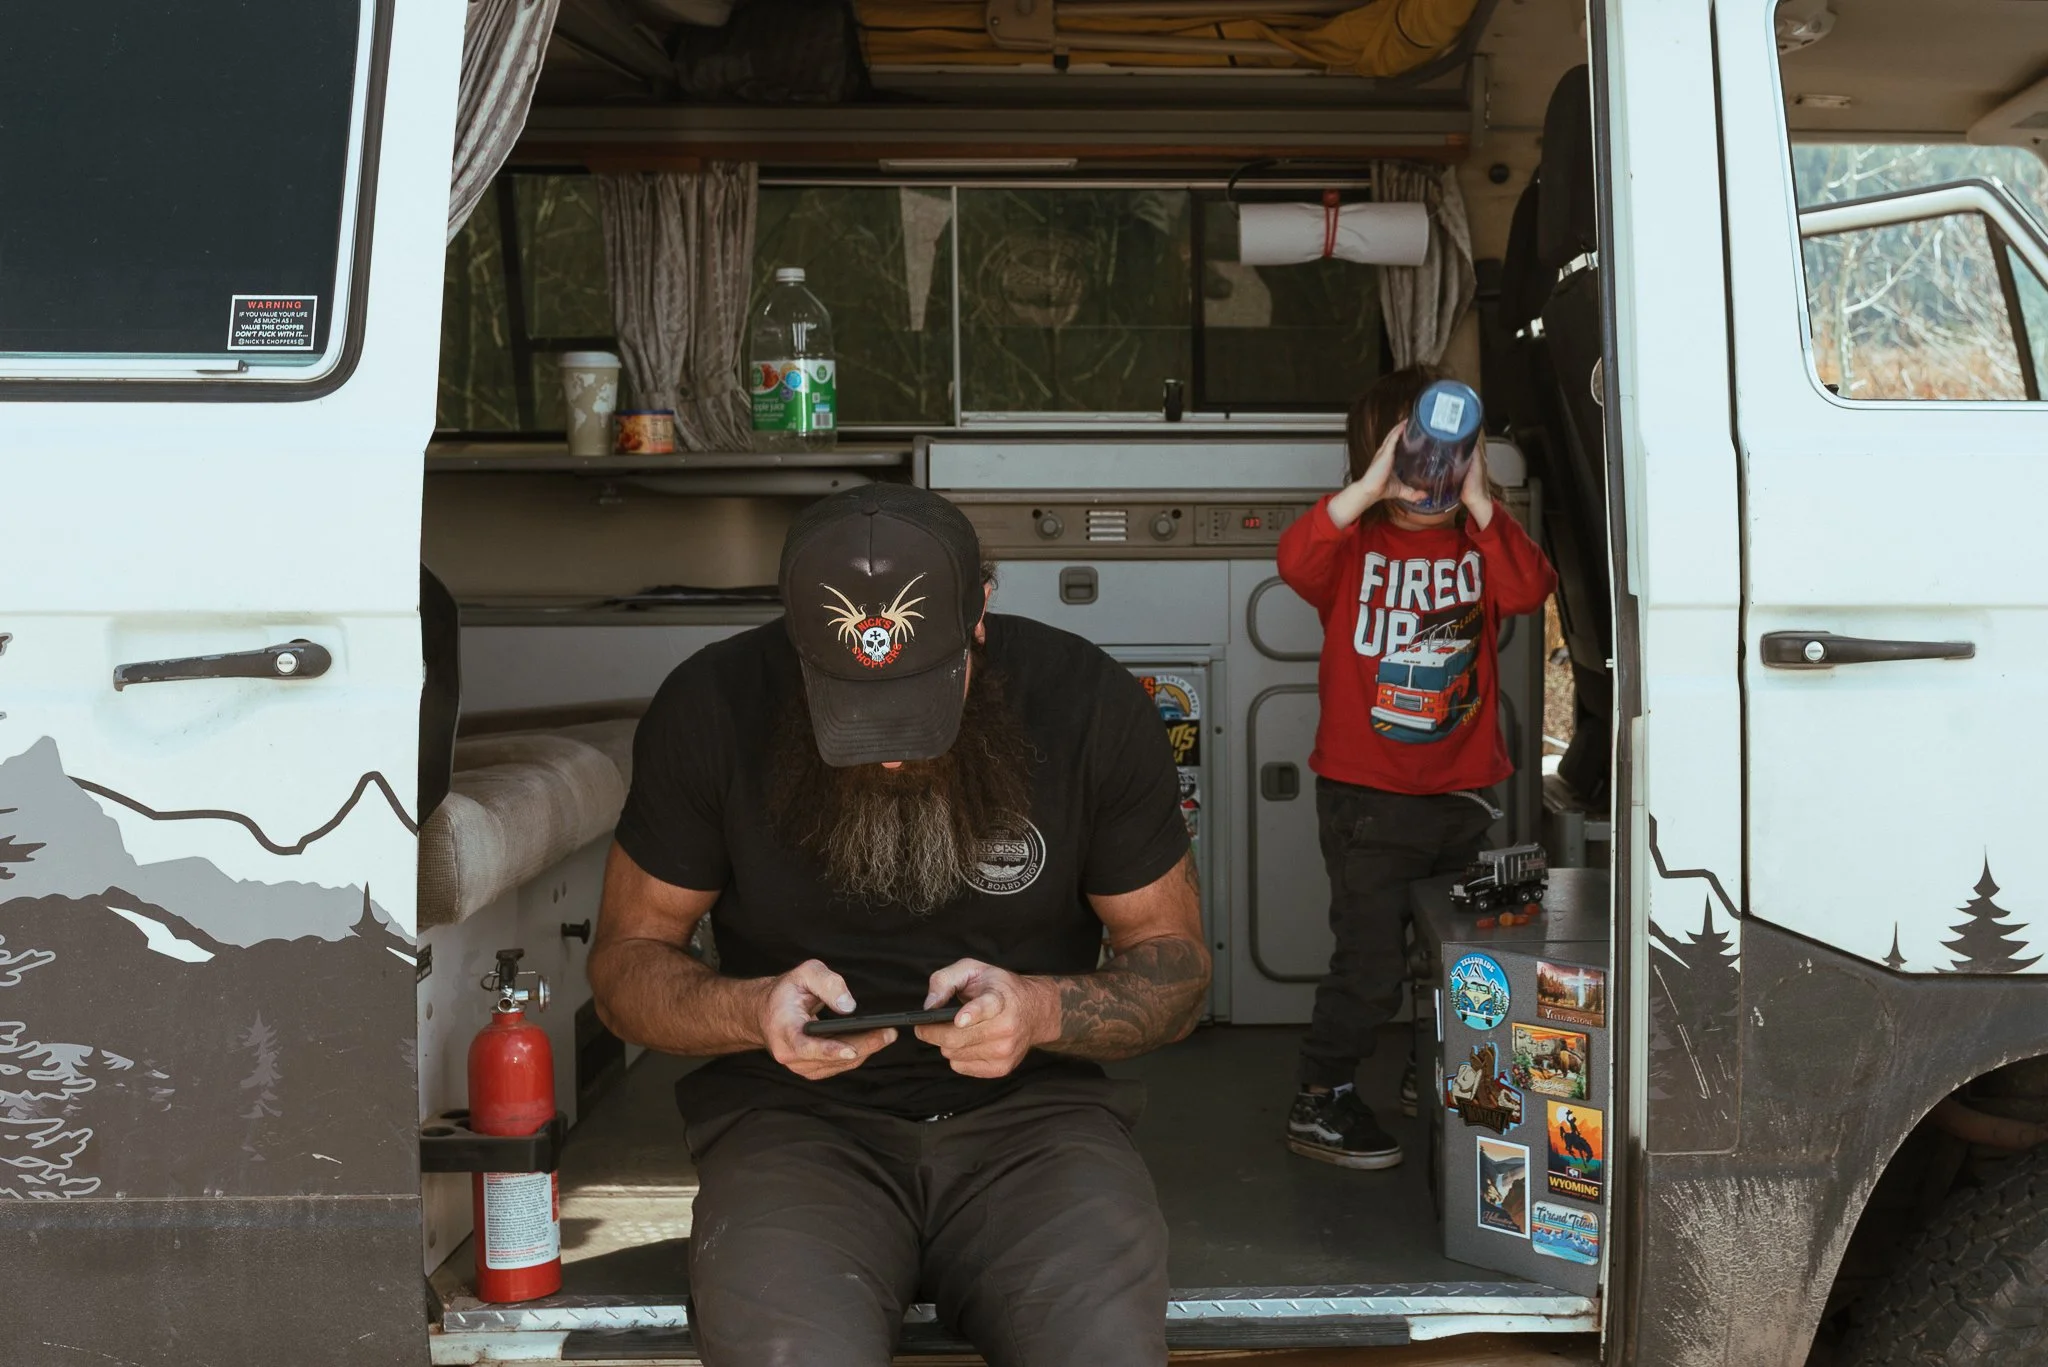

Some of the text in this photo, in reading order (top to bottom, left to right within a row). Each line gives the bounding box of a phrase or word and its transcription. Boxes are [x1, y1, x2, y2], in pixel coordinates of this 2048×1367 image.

[248, 301, 302, 309] WARNING
[1359, 550, 1483, 611] FIRED
[856, 618, 894, 631] NICK'S
[1354, 604, 1420, 657] UP
[851, 643, 903, 669] CHOPPERS
[1462, 695, 1482, 726] SIREN
[977, 842, 1025, 855] RECESS
[987, 880, 1021, 891] BOARD
[1022, 862, 1039, 884] SHOP
[1460, 957, 1496, 973] TELLURIDE
[1548, 1176, 1599, 1197] WYOMING
[1536, 1206, 1568, 1224] Grand
